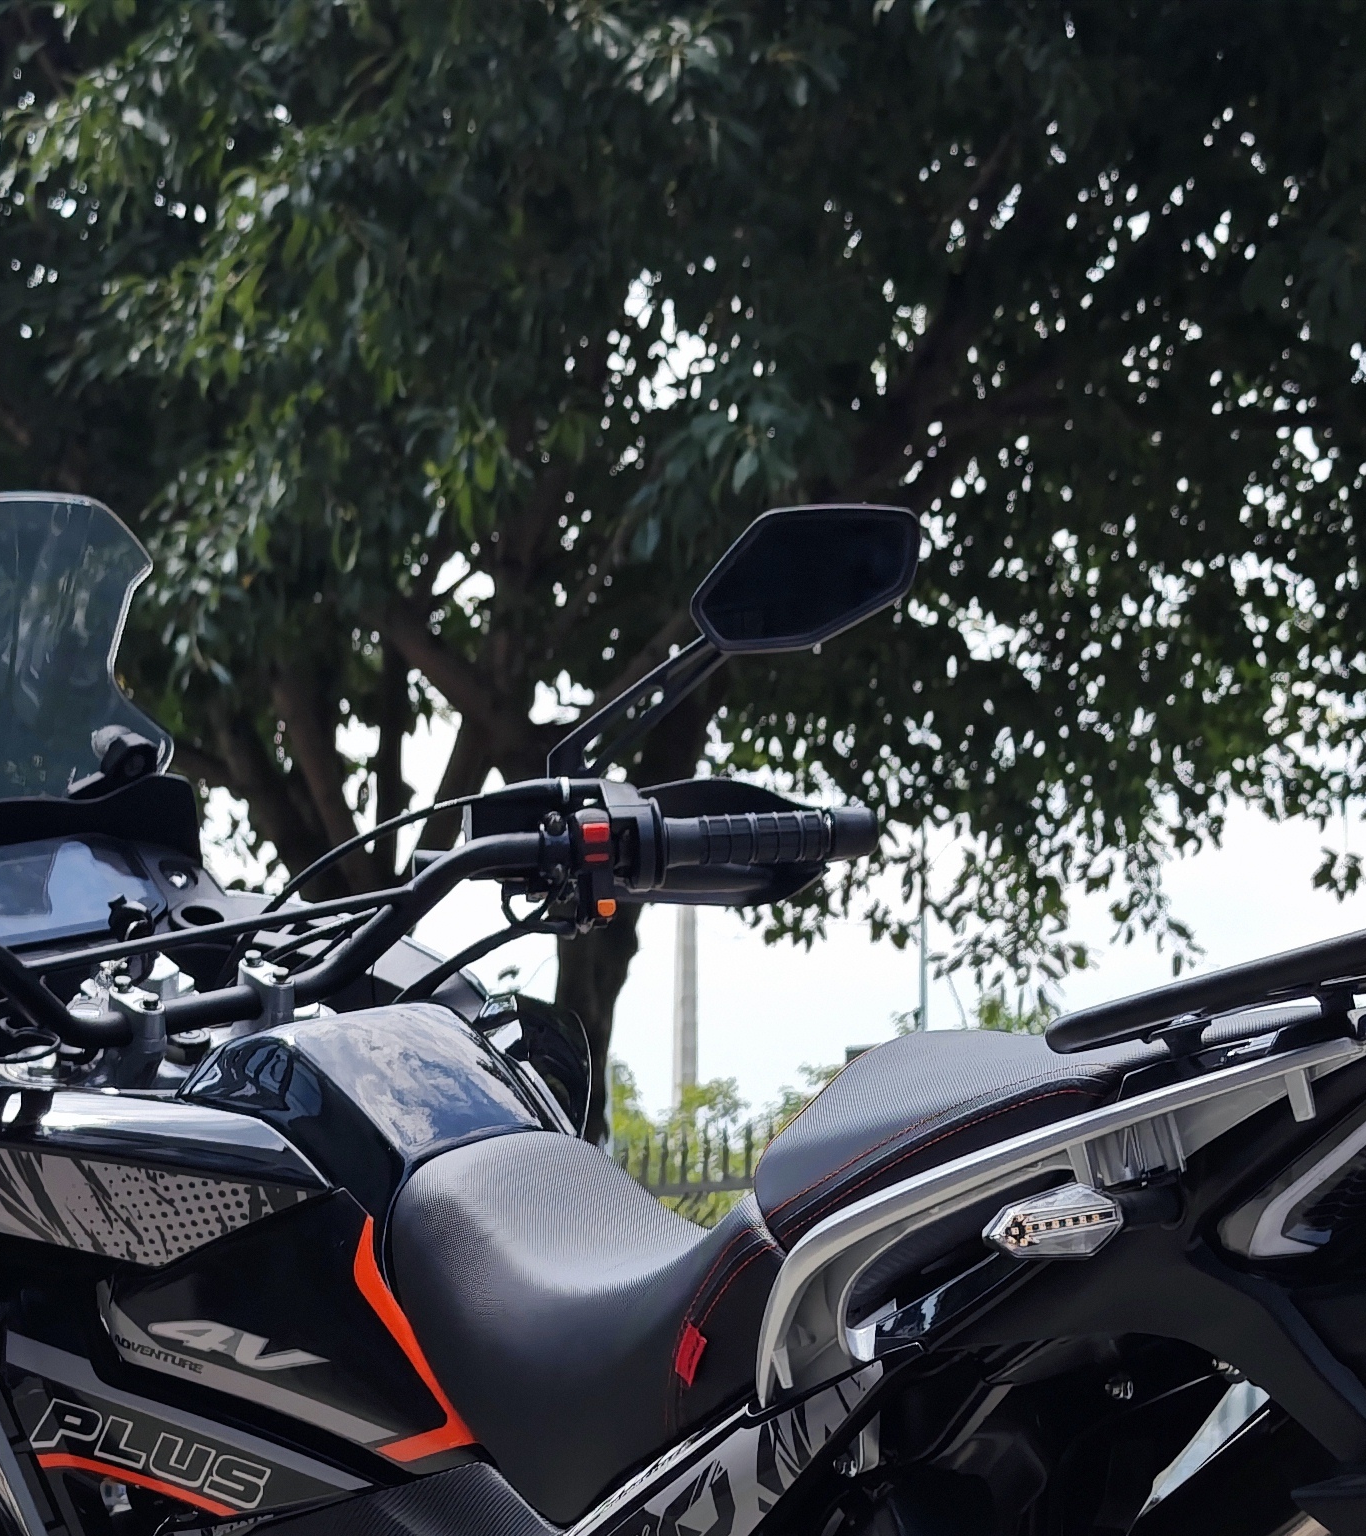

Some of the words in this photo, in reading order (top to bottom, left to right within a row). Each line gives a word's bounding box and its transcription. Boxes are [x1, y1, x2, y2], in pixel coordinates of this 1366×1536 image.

[114, 1334, 203, 1375] ADVENTURE
[148, 1320, 331, 1371] 4V
[29, 1398, 271, 1509] PLUS
